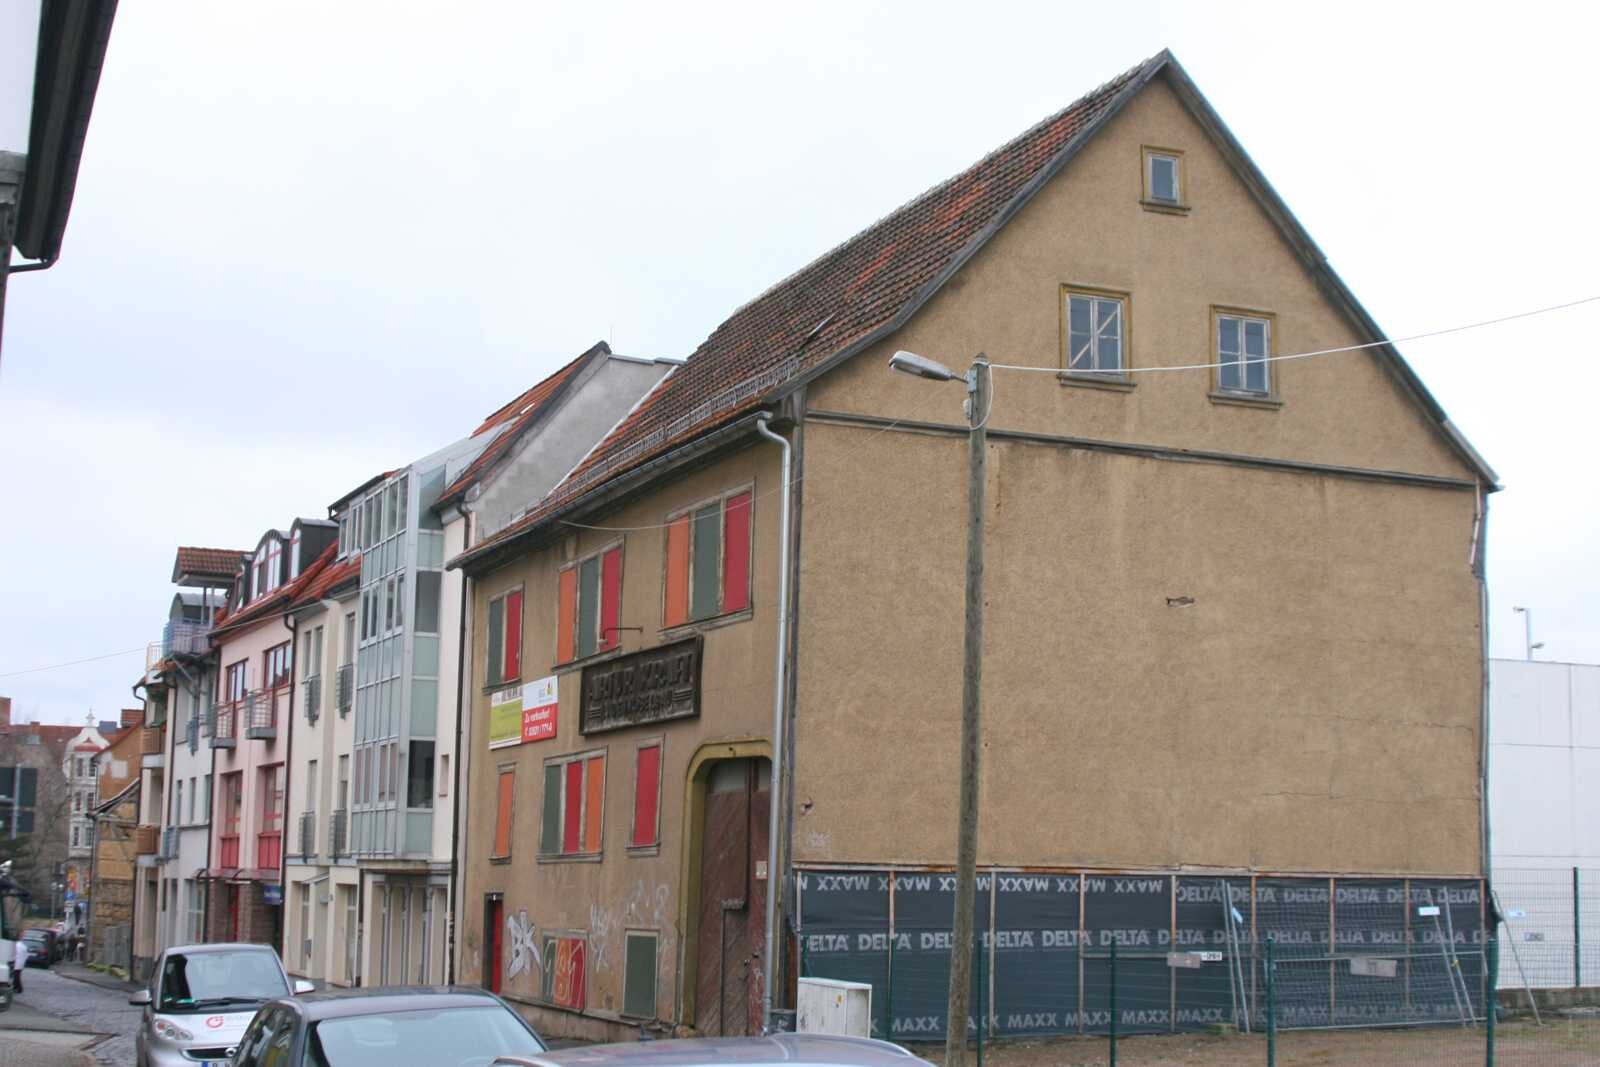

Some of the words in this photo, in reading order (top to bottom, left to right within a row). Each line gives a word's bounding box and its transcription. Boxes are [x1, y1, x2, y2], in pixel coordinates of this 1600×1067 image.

[817, 875, 870, 891] MAXX
[939, 876, 991, 892] MXX
[999, 877, 1049, 893] MAXX
[1114, 879, 1163, 893] MAXX
[1231, 887, 1276, 902] DETA
[1284, 888, 1328, 903] DELTA
[1336, 888, 1379, 903] DELTA
[1387, 888, 1434, 903] DETA
[1042, 930, 1093, 947] DELTA
[1101, 929, 1150, 946] DELTA
[1008, 1012, 1057, 1029] MAXX
[1121, 1009, 1169, 1025] MAXX
[1177, 1007, 1224, 1023] MAXX
